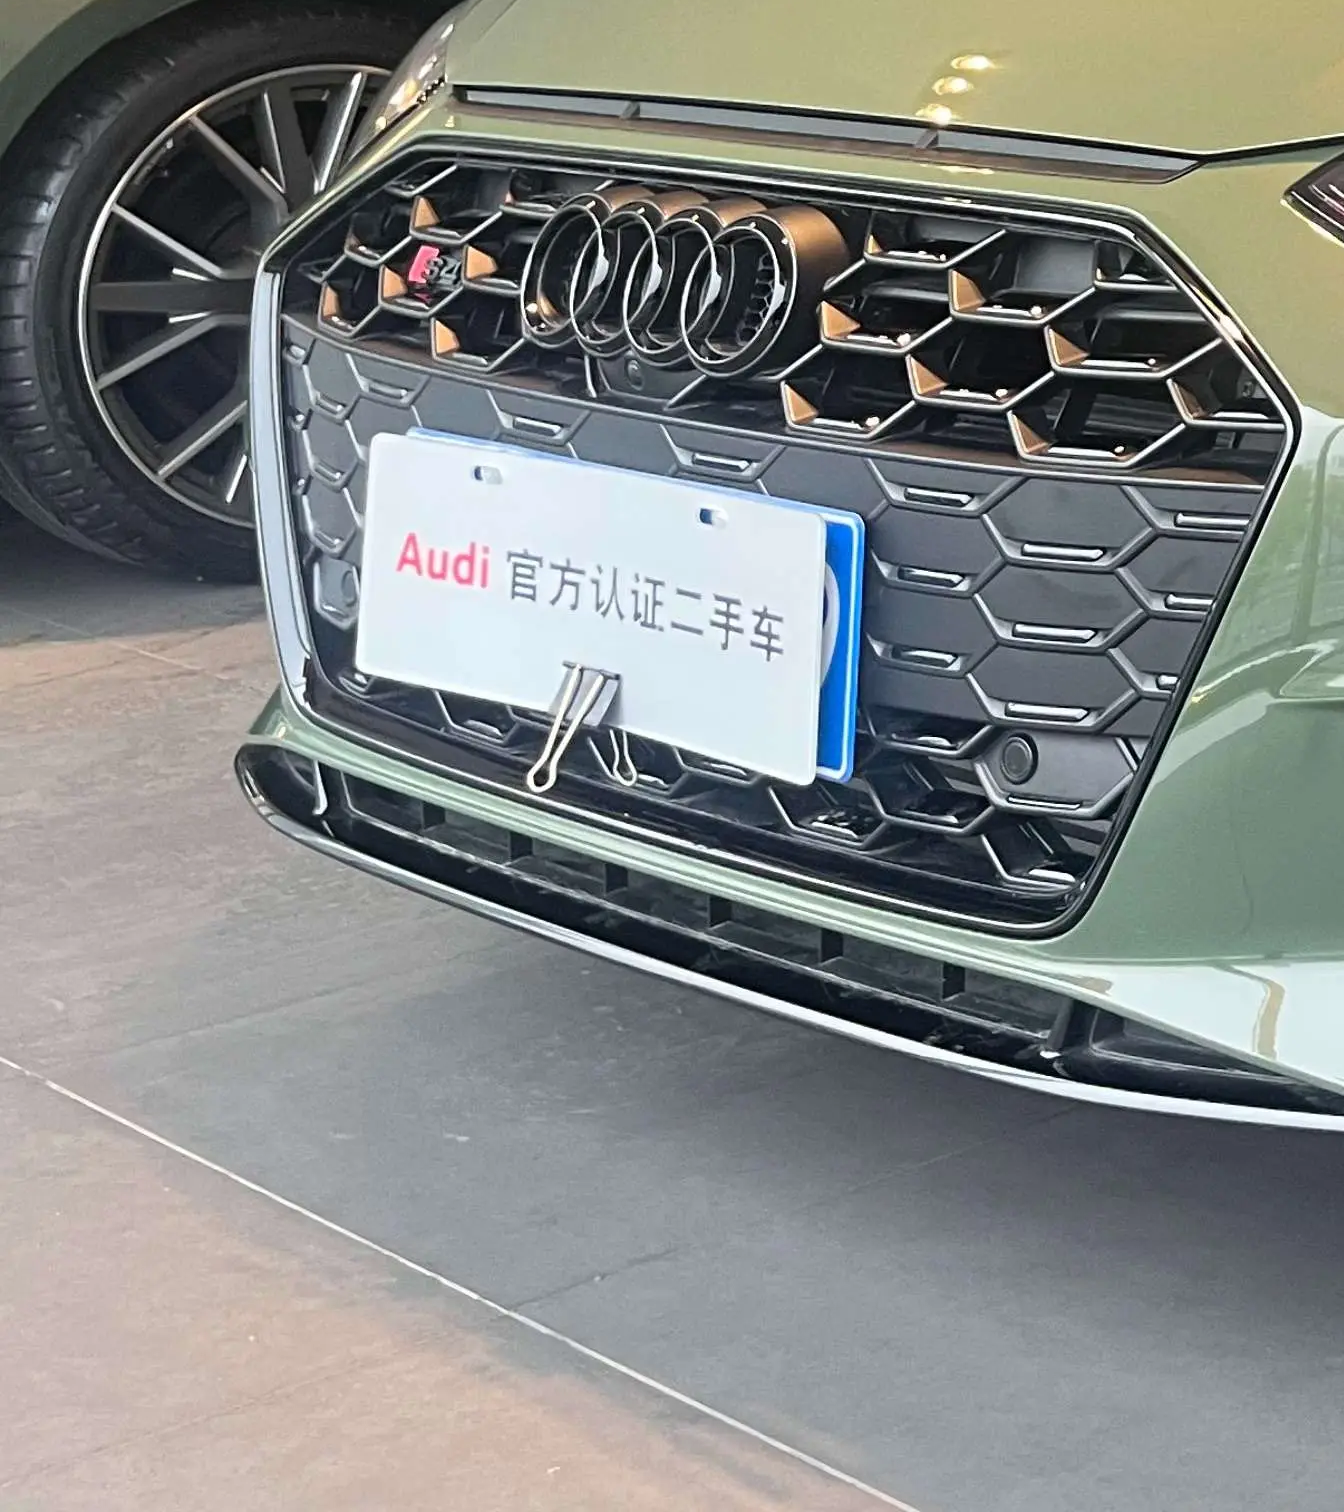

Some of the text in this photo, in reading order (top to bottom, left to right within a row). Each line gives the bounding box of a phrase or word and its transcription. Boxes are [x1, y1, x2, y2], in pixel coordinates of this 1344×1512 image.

[423, 255, 462, 287] S4
[396, 533, 490, 587] Audi
[507, 550, 785, 662] 官方认证二手车
